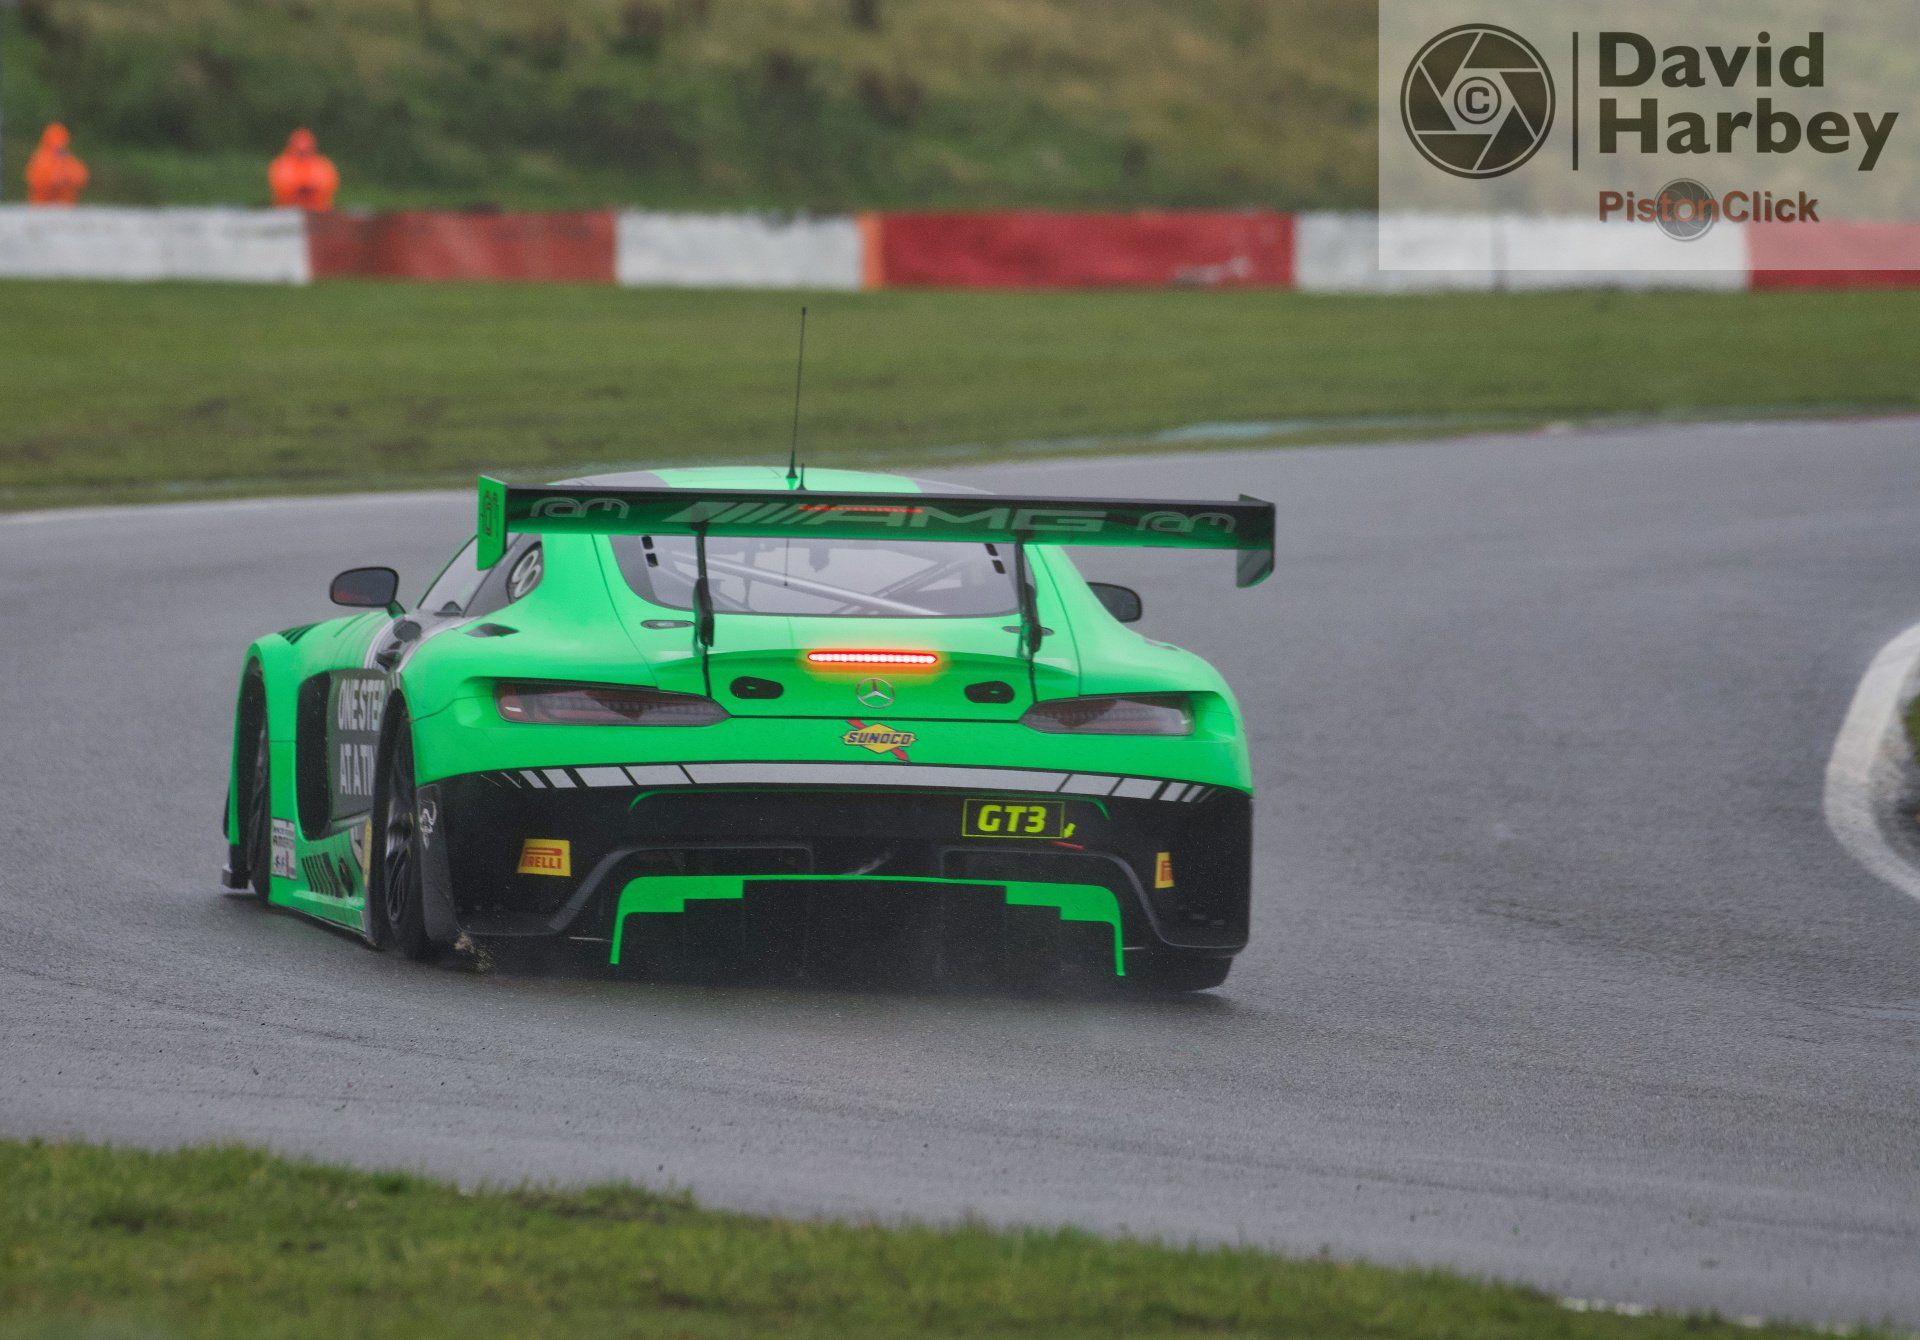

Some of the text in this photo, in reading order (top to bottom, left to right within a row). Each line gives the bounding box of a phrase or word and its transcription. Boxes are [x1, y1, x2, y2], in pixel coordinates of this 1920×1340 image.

[338, 678, 360, 731] ONE
[847, 732, 912, 745] SUNOCO
[977, 803, 1048, 834] GT3
